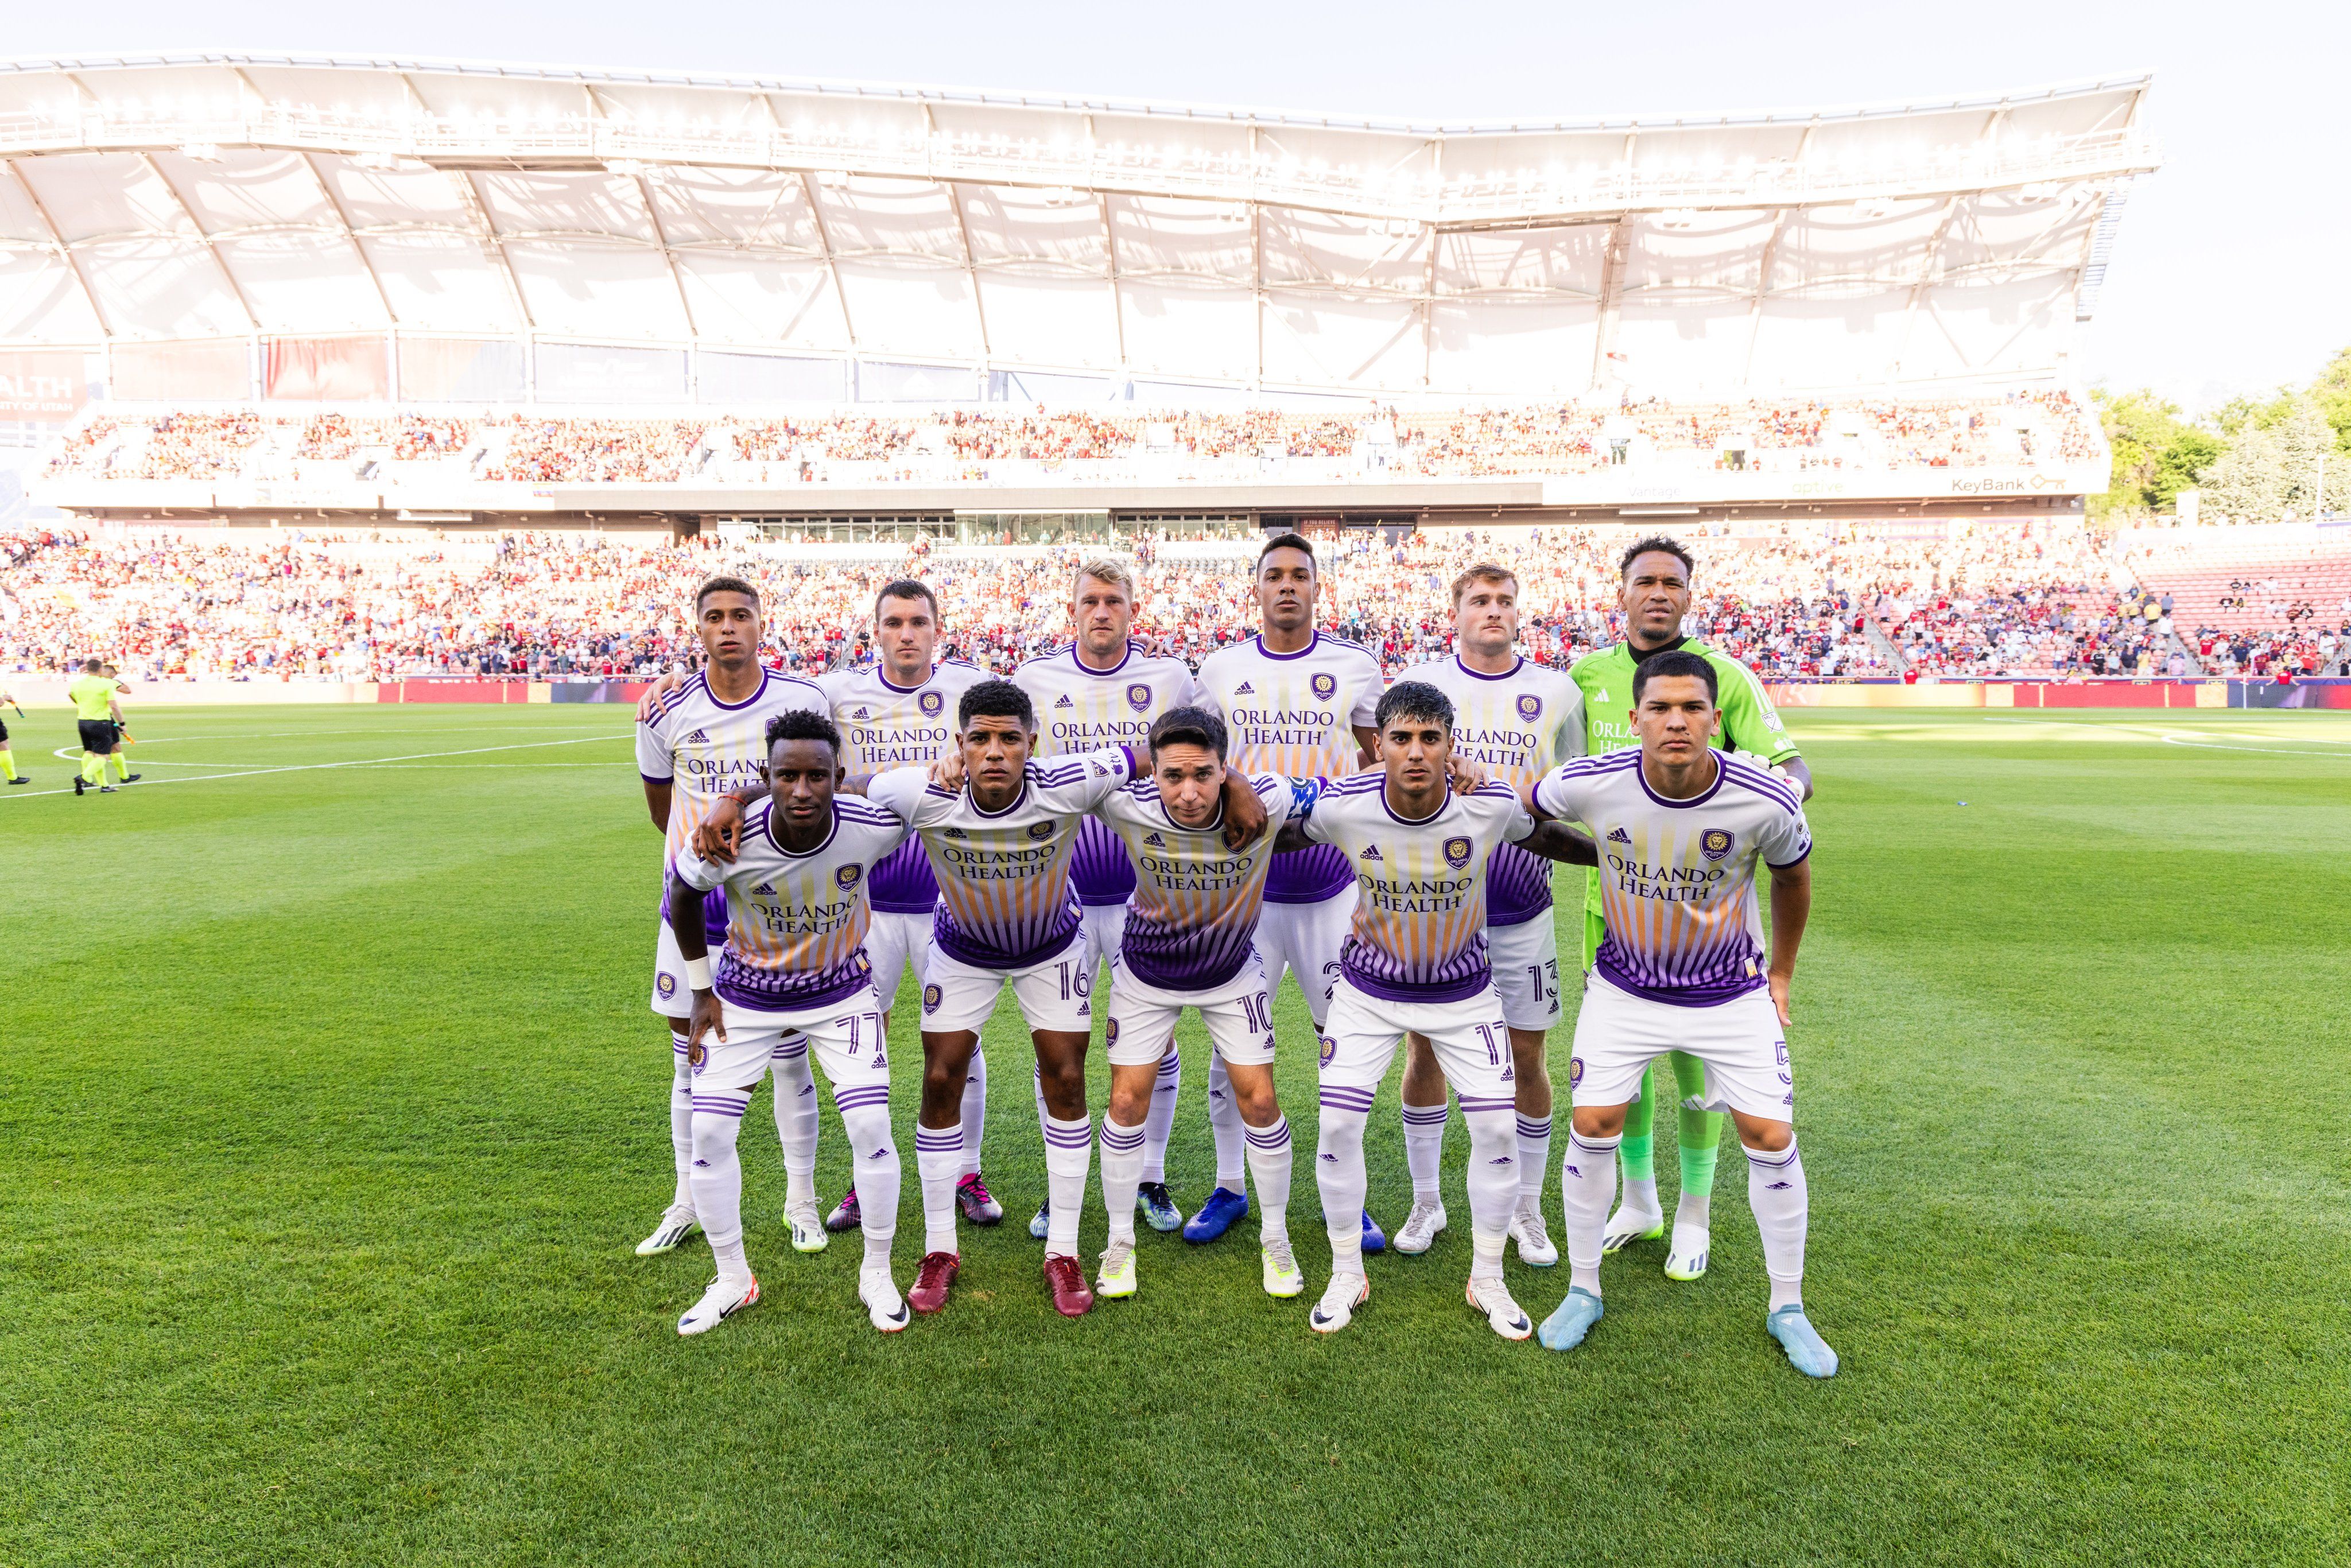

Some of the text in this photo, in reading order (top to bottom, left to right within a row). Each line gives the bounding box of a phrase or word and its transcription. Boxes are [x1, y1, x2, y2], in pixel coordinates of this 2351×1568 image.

[23, 402, 39, 411] OF
[41, 403, 73, 412] UTAH
[1628, 487, 1681, 499] Vantage
[1792, 480, 1844, 496] aptive
[1952, 478, 2025, 494] KeyBank
[1232, 709, 1334, 725] ORLANDO
[851, 728, 948, 745] ORLANDO
[1052, 721, 1151, 739] ORLANDO
[1452, 728, 1537, 748] RLANDO
[1593, 720, 1640, 738] ORLA
[688, 759, 768, 774] ORLAN
[700, 777, 762, 793] HEAT
[1143, 839, 1166, 847] adidas
[1607, 835, 1631, 844] adidas
[944, 845, 1056, 864] ORLANDO
[1140, 857, 1252, 875] ORLANDO
[1607, 854, 1725, 883] ORLANDO
[1359, 874, 1472, 894] ORLANDO
[750, 894, 858, 918] ORLANDO
[766, 913, 848, 935] HEALTH
[1054, 960, 1090, 1000] 16
[1528, 958, 1559, 1002] 13
[1236, 991, 1274, 1034] 10
[835, 1012, 884, 1054] 77
[1775, 1041, 1792, 1085] 5
